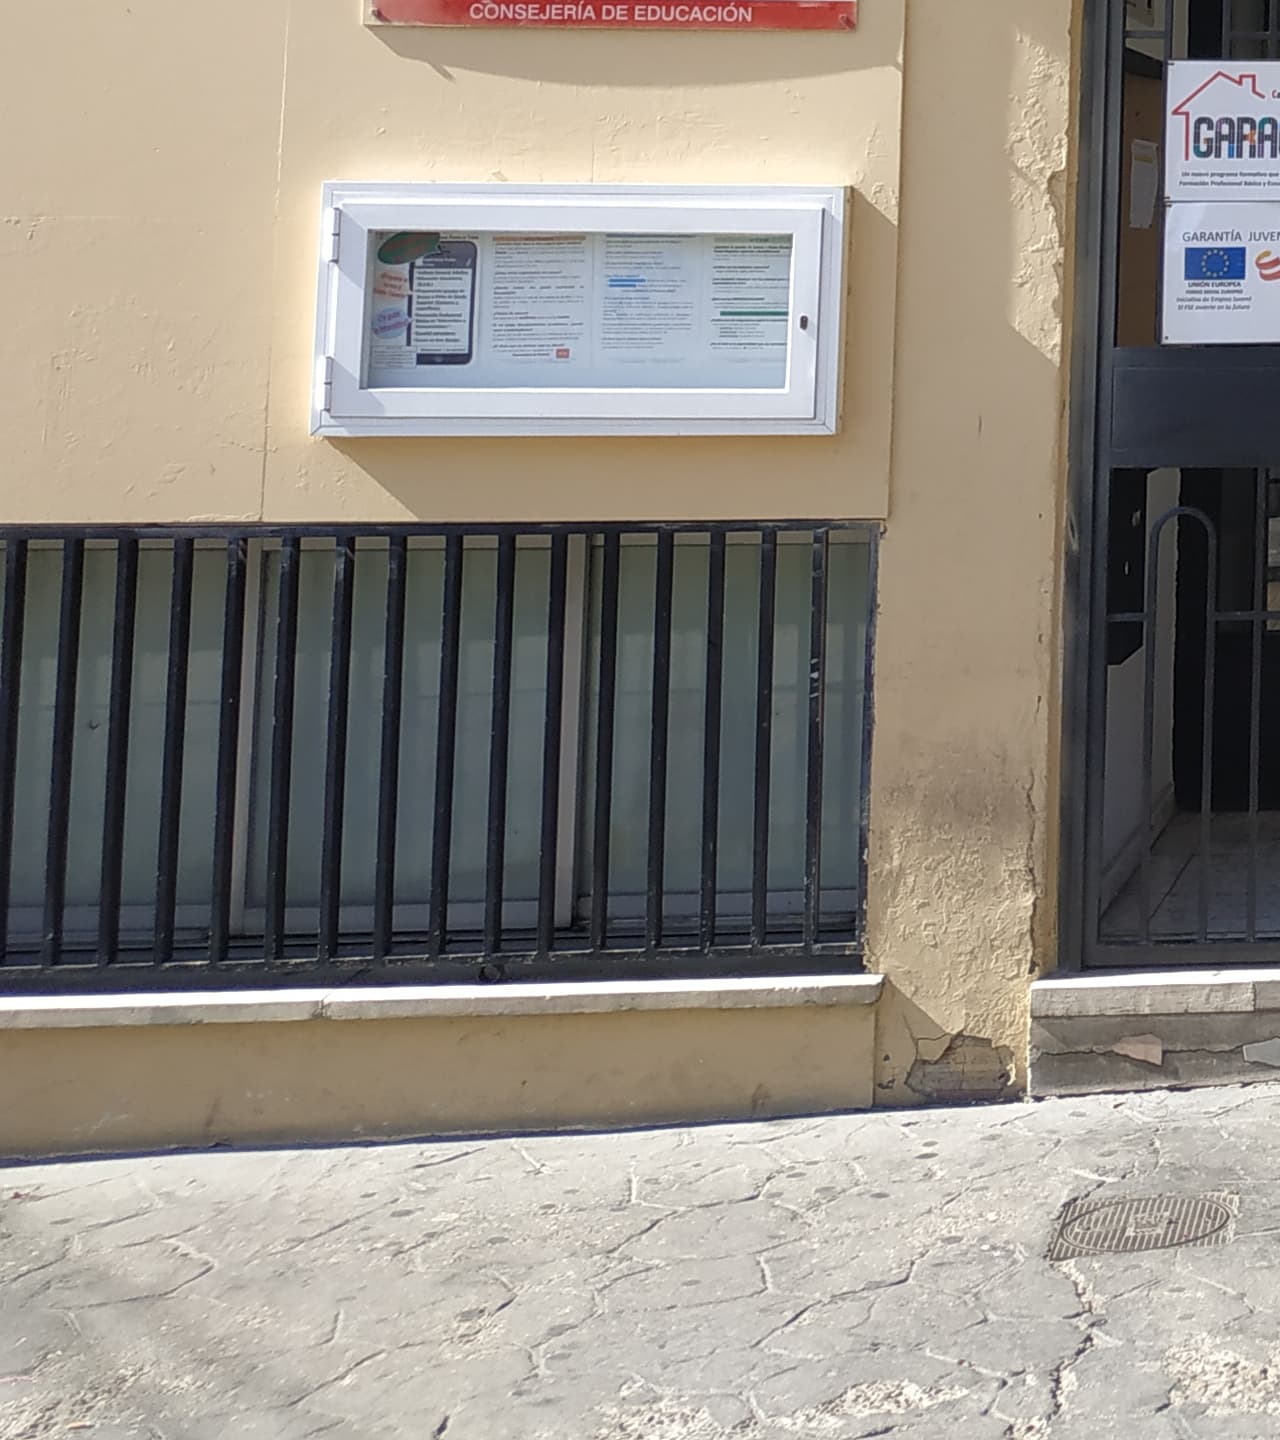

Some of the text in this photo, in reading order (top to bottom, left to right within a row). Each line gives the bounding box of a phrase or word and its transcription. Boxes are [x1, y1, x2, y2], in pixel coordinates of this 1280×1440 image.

[469, 2, 752, 23] CONSEJERÍA DE EDUCACIÓN
[1182, 229, 1242, 241] GARANTÍA
